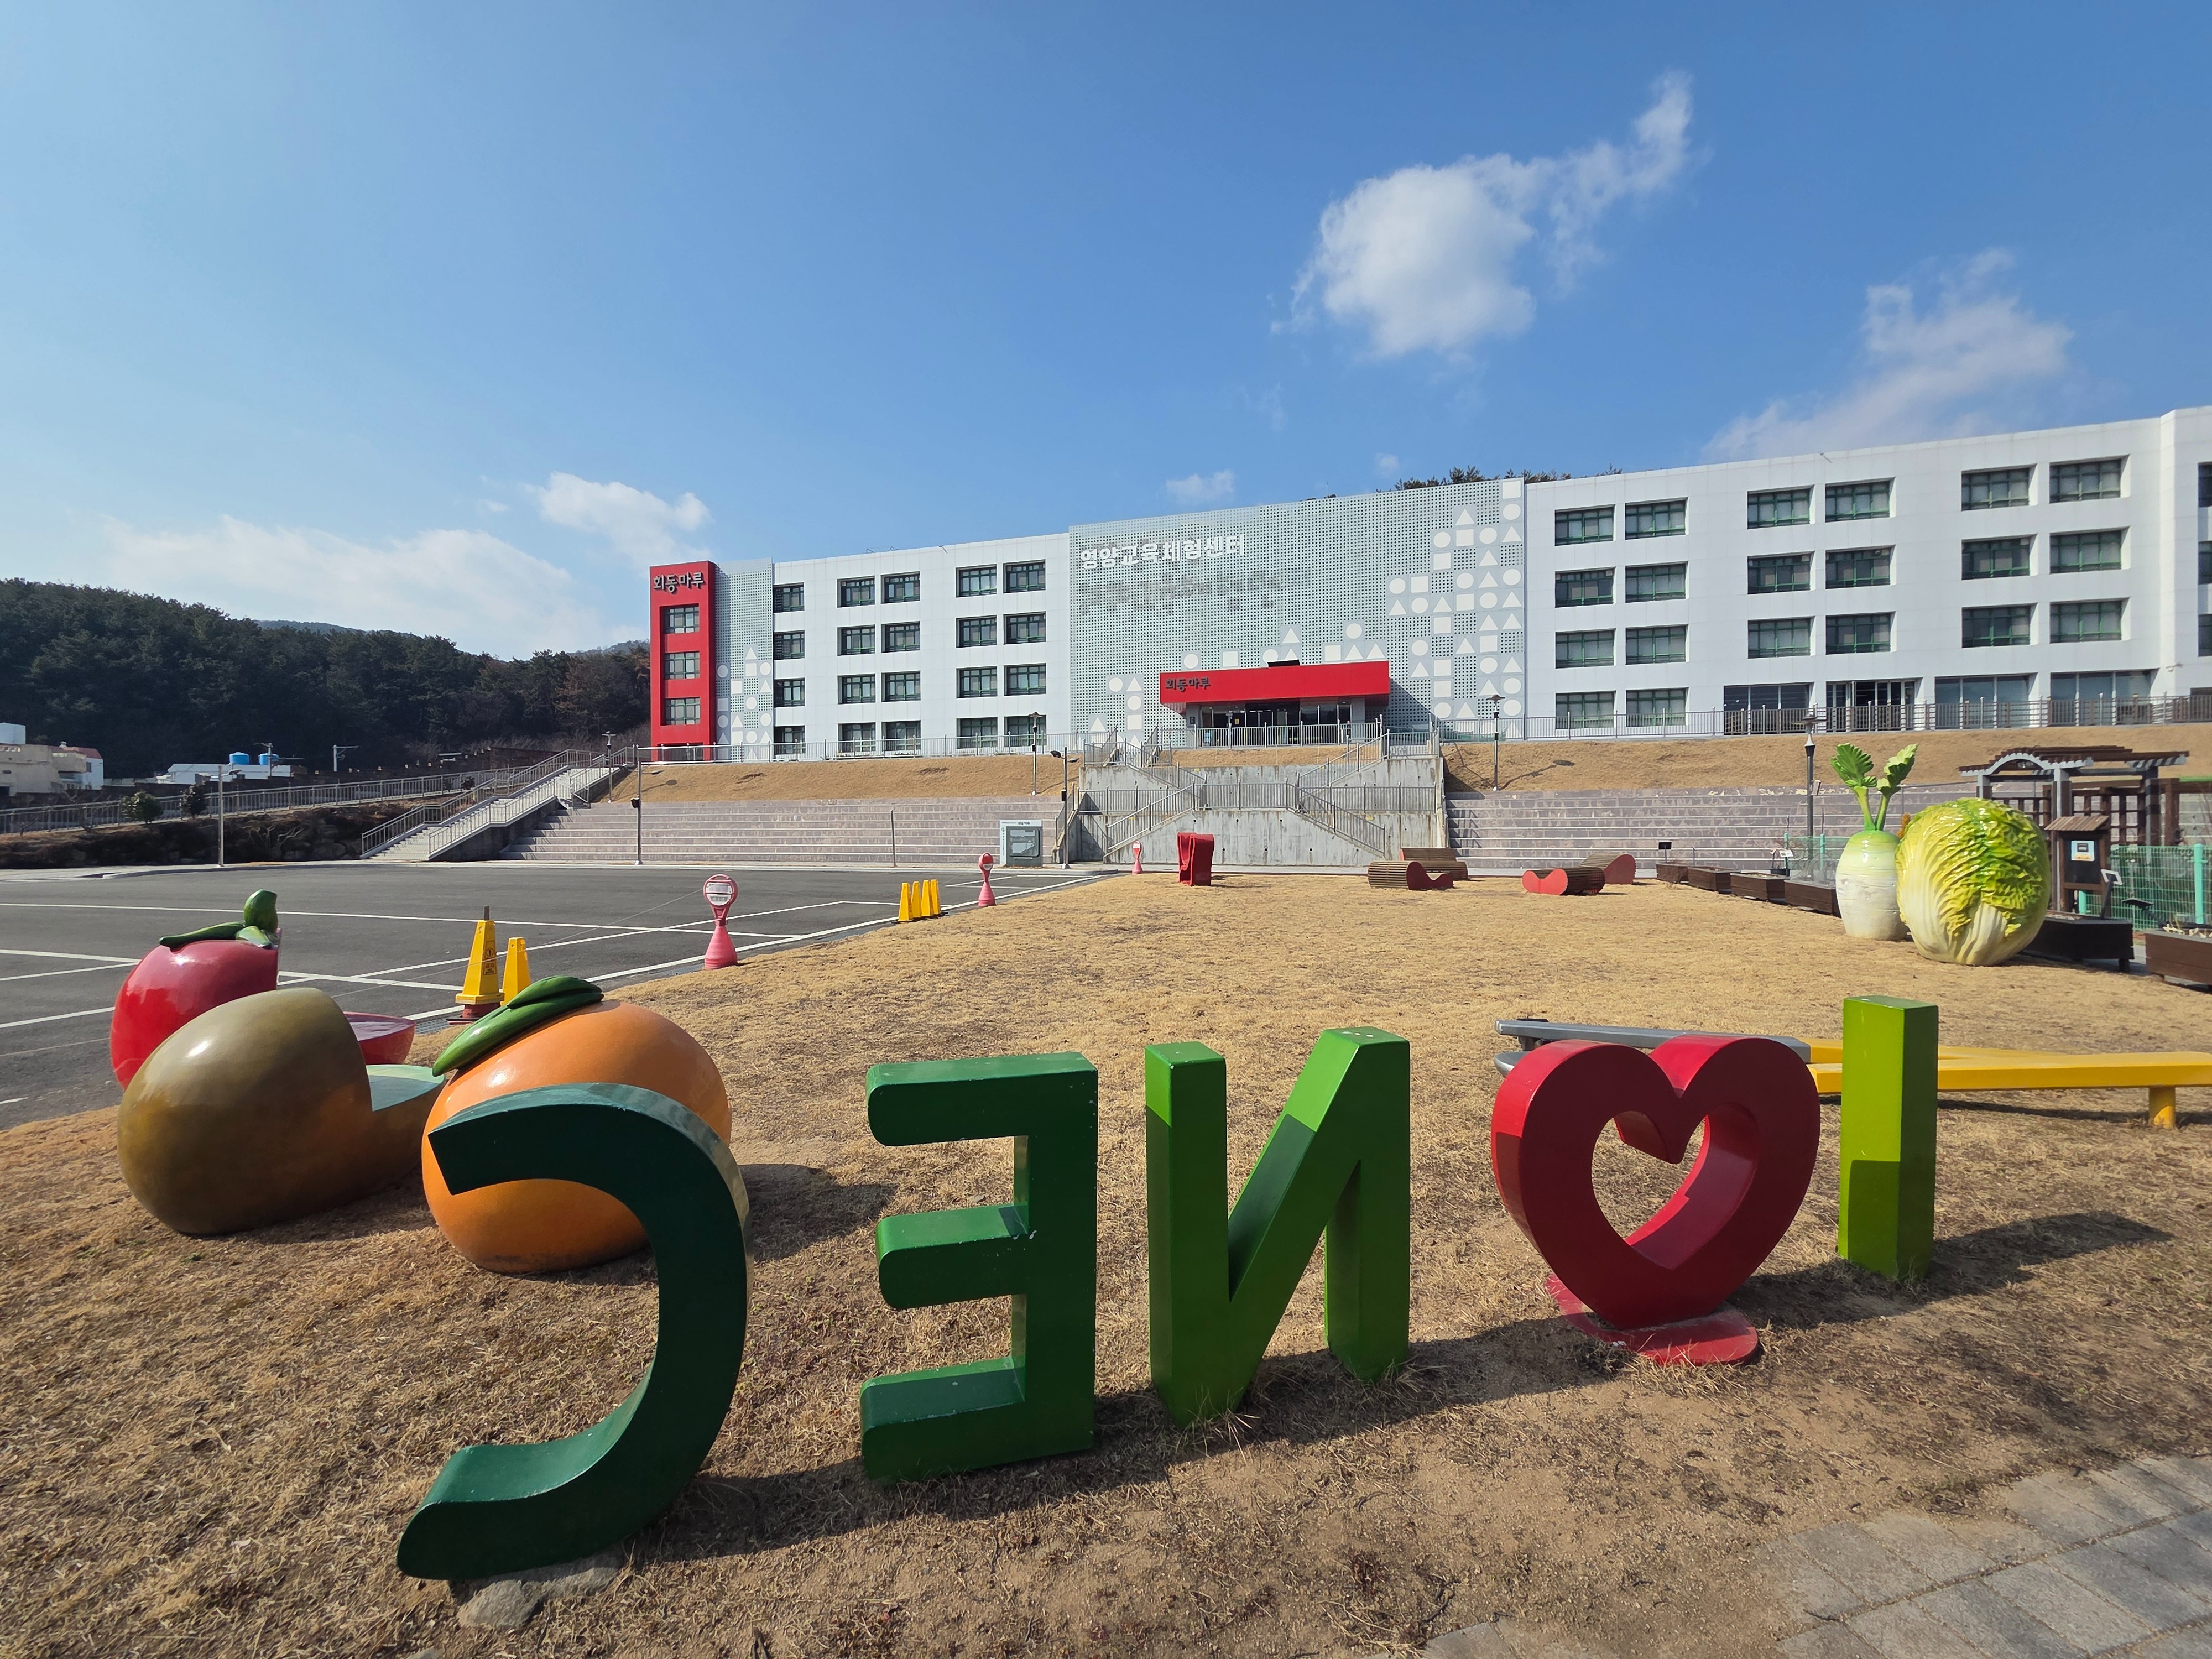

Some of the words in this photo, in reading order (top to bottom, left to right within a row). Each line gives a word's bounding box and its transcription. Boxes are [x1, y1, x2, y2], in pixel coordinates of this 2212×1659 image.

[1081, 534, 1244, 570] 영양교육체험센터
[653, 571, 704, 593] 회동마루
[1165, 677, 1211, 692] 회동마루
